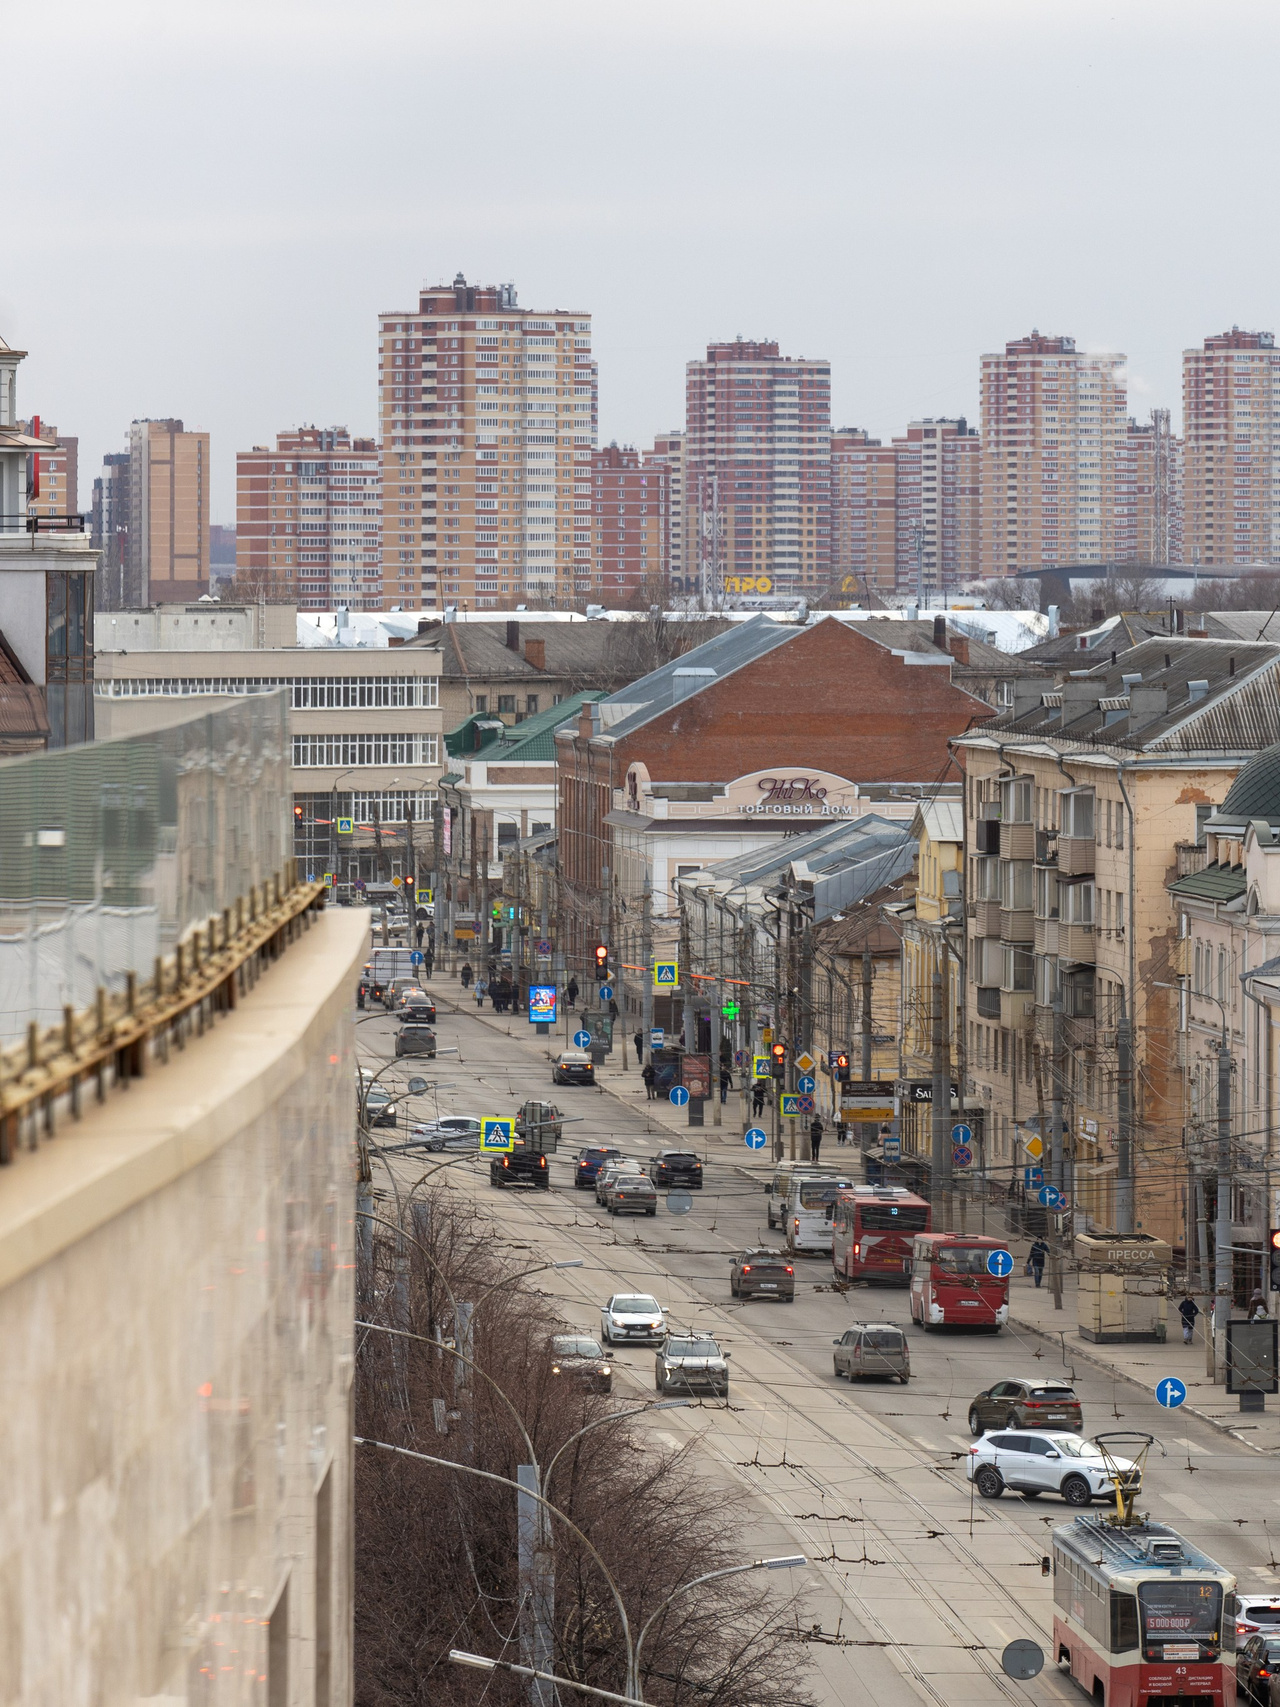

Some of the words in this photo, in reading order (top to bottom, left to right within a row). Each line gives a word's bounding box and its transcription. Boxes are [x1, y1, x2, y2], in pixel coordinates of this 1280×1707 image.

[724, 576, 772, 593] ПРО
[758, 777, 828, 801] НиКо
[738, 803, 813, 815] ТОРГОВЫЙ
[821, 804, 853, 815] ДОМ
[1107, 1249, 1156, 1260] ПРЕССА
[1199, 1586, 1213, 1597] 12
[1149, 1618, 1155, 1628] 5
[1175, 1666, 1187, 1675] 43
